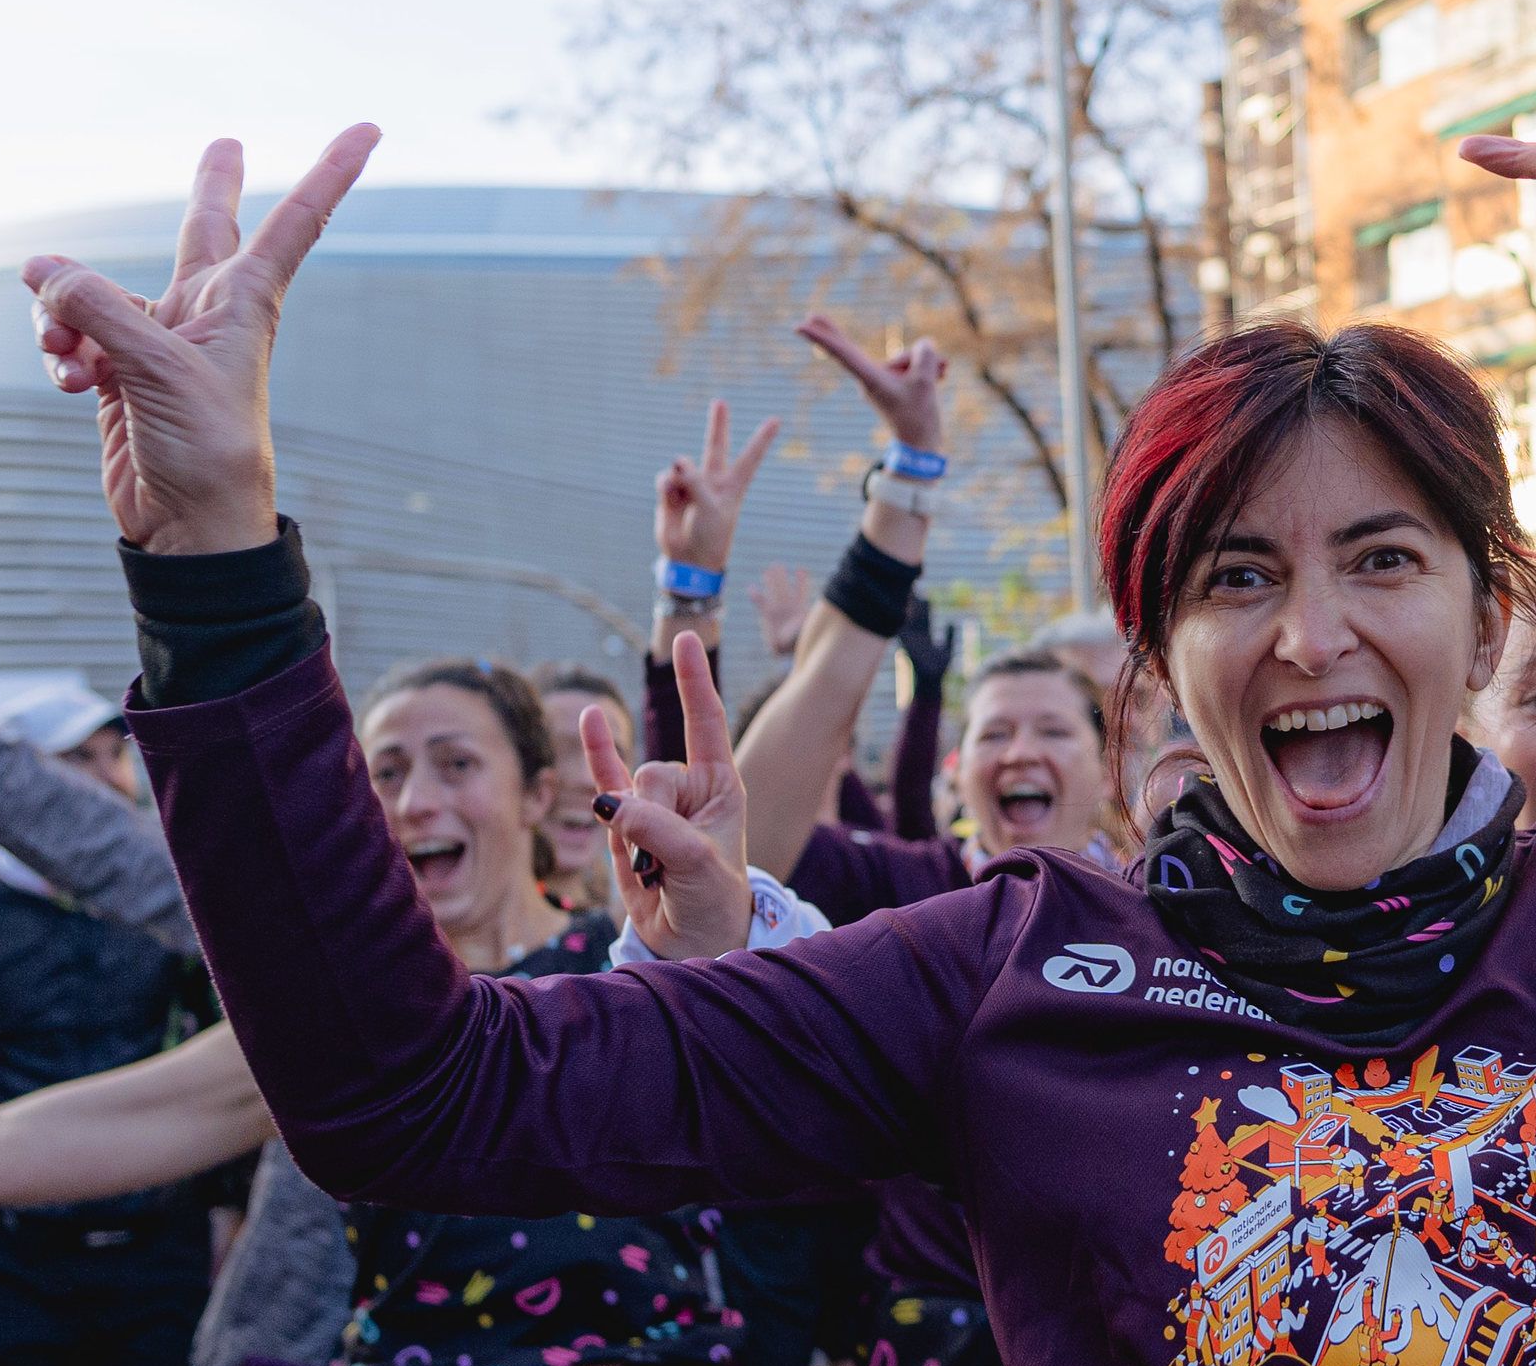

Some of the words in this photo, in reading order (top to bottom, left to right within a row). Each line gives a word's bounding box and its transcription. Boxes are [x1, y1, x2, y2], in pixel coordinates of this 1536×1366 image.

[1311, 1121, 1336, 1139] Metro
[1231, 1199, 1272, 1238] nationale
[1231, 1199, 1288, 1249] nederlanden
